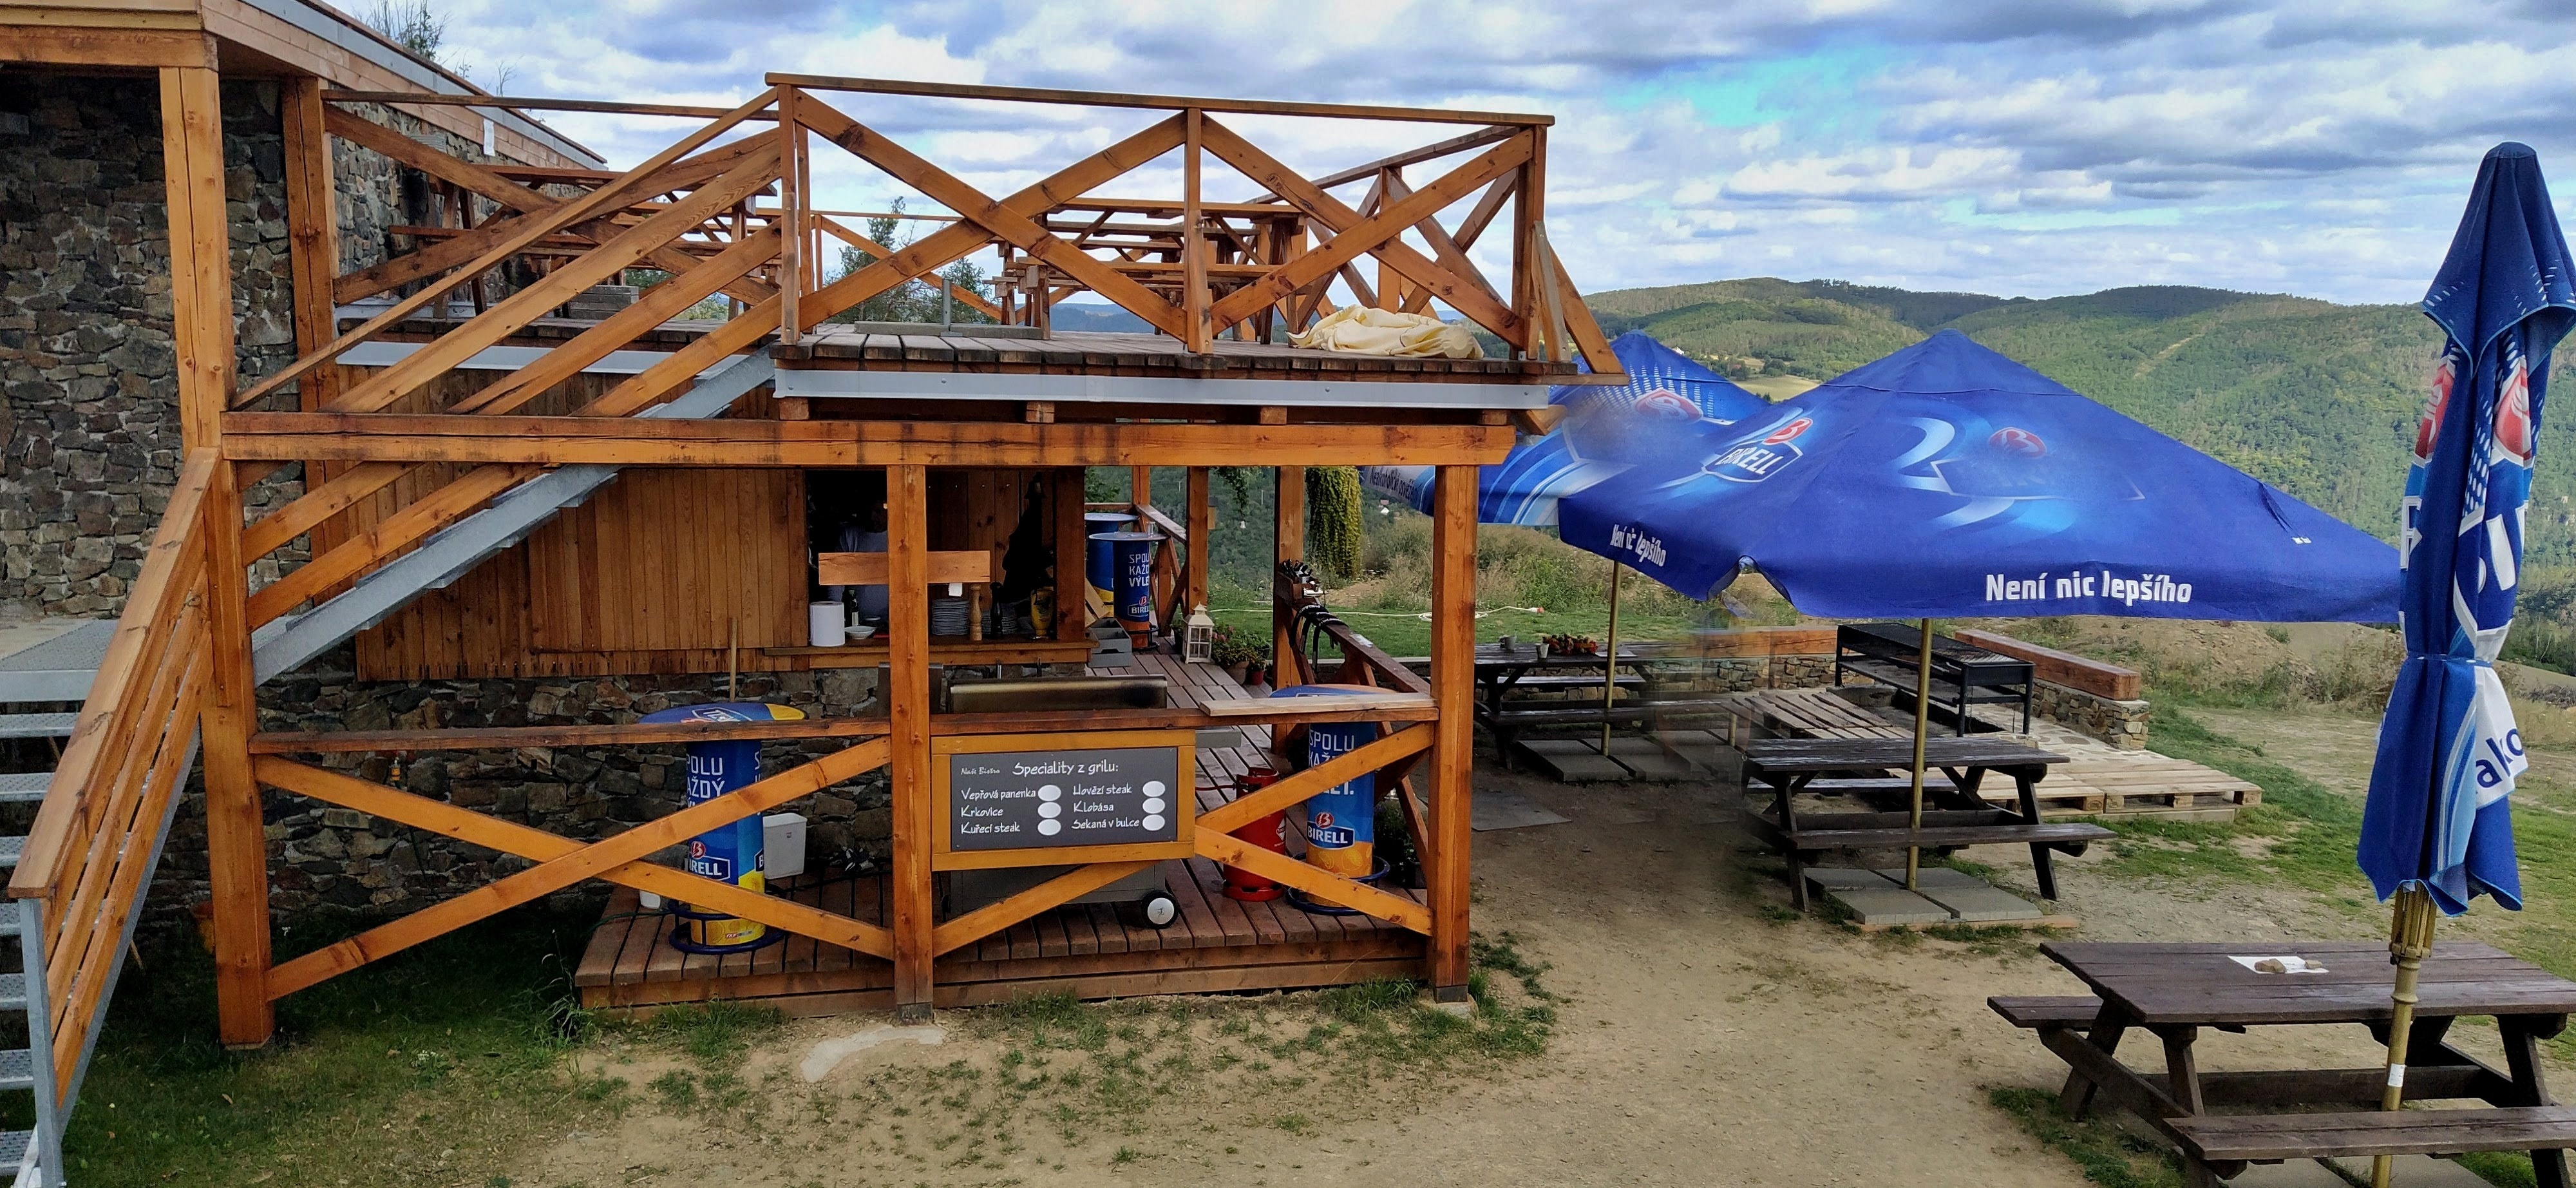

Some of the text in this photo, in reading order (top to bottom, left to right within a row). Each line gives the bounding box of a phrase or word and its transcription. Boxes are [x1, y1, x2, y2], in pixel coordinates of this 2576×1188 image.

[1129, 564, 1150, 575] KAŽD
[1129, 575, 1150, 588] VÝLE
[1985, 570, 2193, 606] Není nic lepšího
[687, 753, 723, 775] POLU
[1012, 761, 1074, 777] Speciality
[1077, 765, 1085, 773] z
[1088, 759, 1119, 775] grilu:
[687, 776, 725, 798] AŽDÝ
[1073, 782, 1132, 795] Hovězí steak
[961, 787, 1036, 801] Vepřová panenka
[961, 805, 1003, 818] Krkovice
[1074, 800, 1114, 812] Klobása
[961, 821, 1021, 834] Kuřecí steak
[1071, 817, 1140, 829] Sekaná v bulce
[1308, 825, 1348, 845] BIRELL
[689, 859, 722, 876] IRELL
